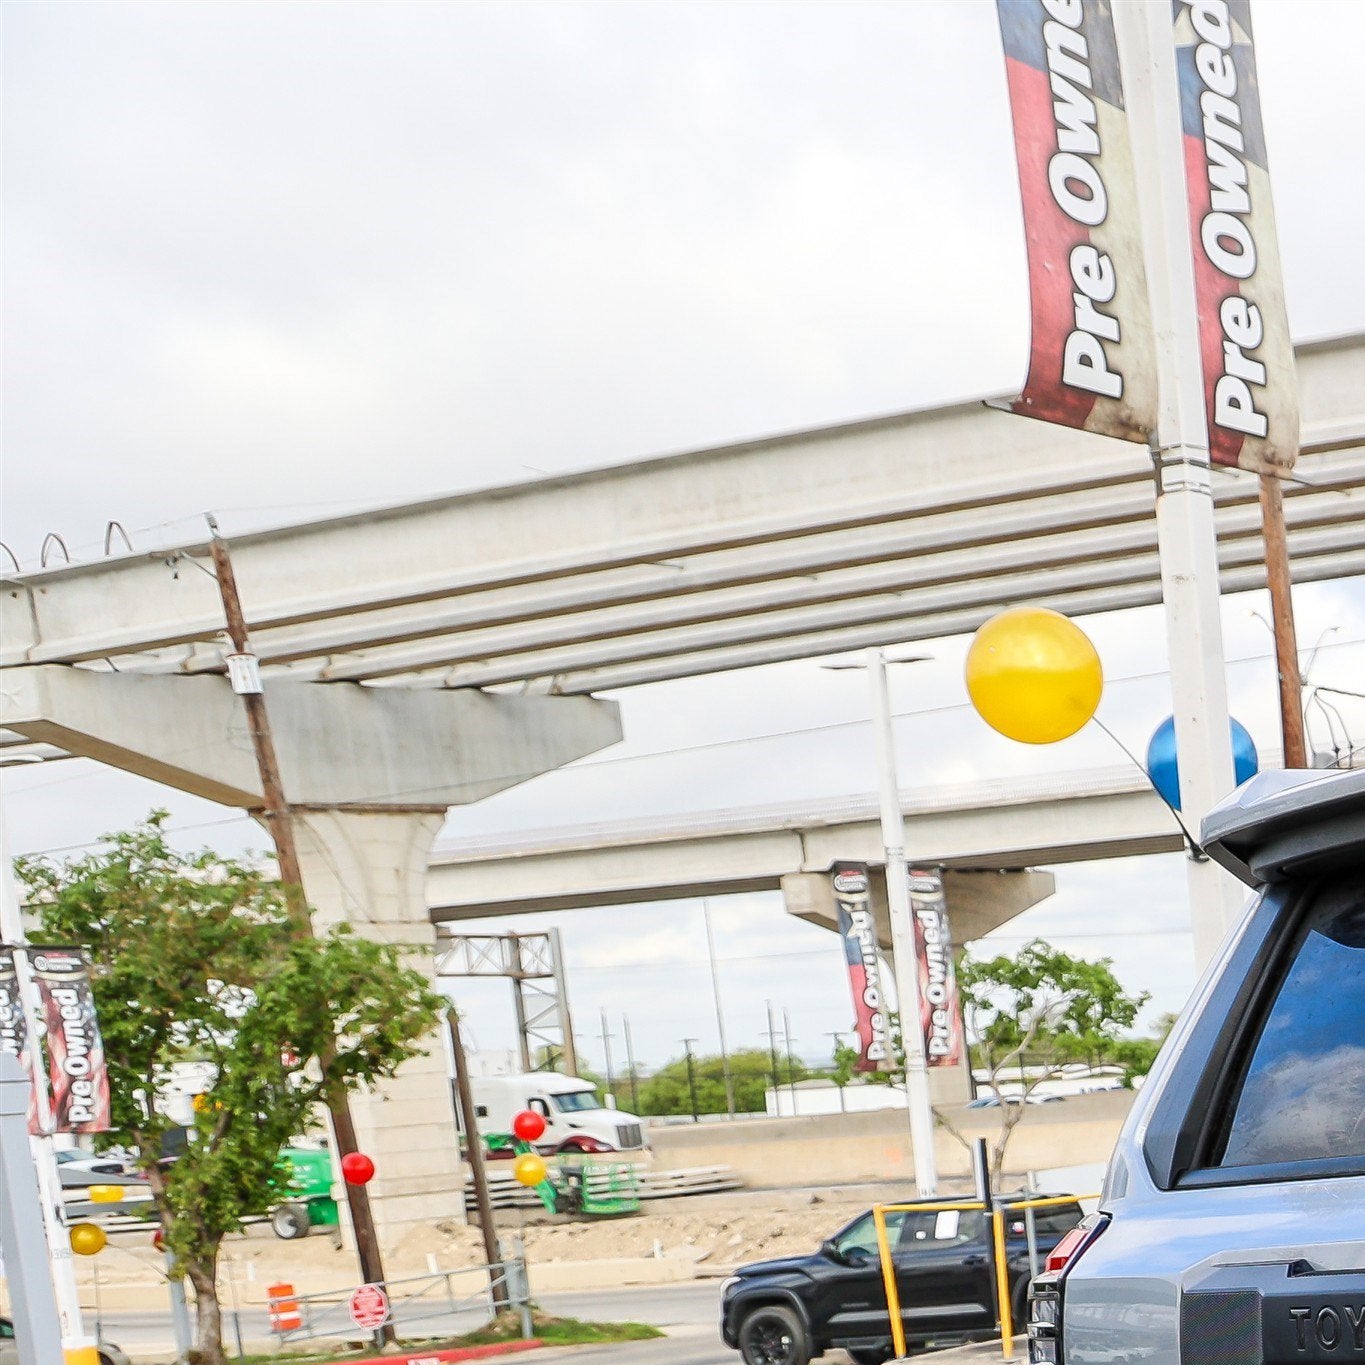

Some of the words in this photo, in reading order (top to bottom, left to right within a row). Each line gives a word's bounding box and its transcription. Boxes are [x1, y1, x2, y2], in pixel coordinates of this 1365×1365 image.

[1180, 0, 1257, 279] Owned
[1062, 245, 1122, 399] Pre
[1215, 296, 1268, 438] Pre
[850, 910, 880, 1009] Owned
[917, 909, 946, 1005] Owned
[51, 988, 91, 1077] Owned
[867, 1012, 886, 1061] Pre
[928, 1008, 949, 1056] Pre
[68, 1079, 95, 1123] Pre
